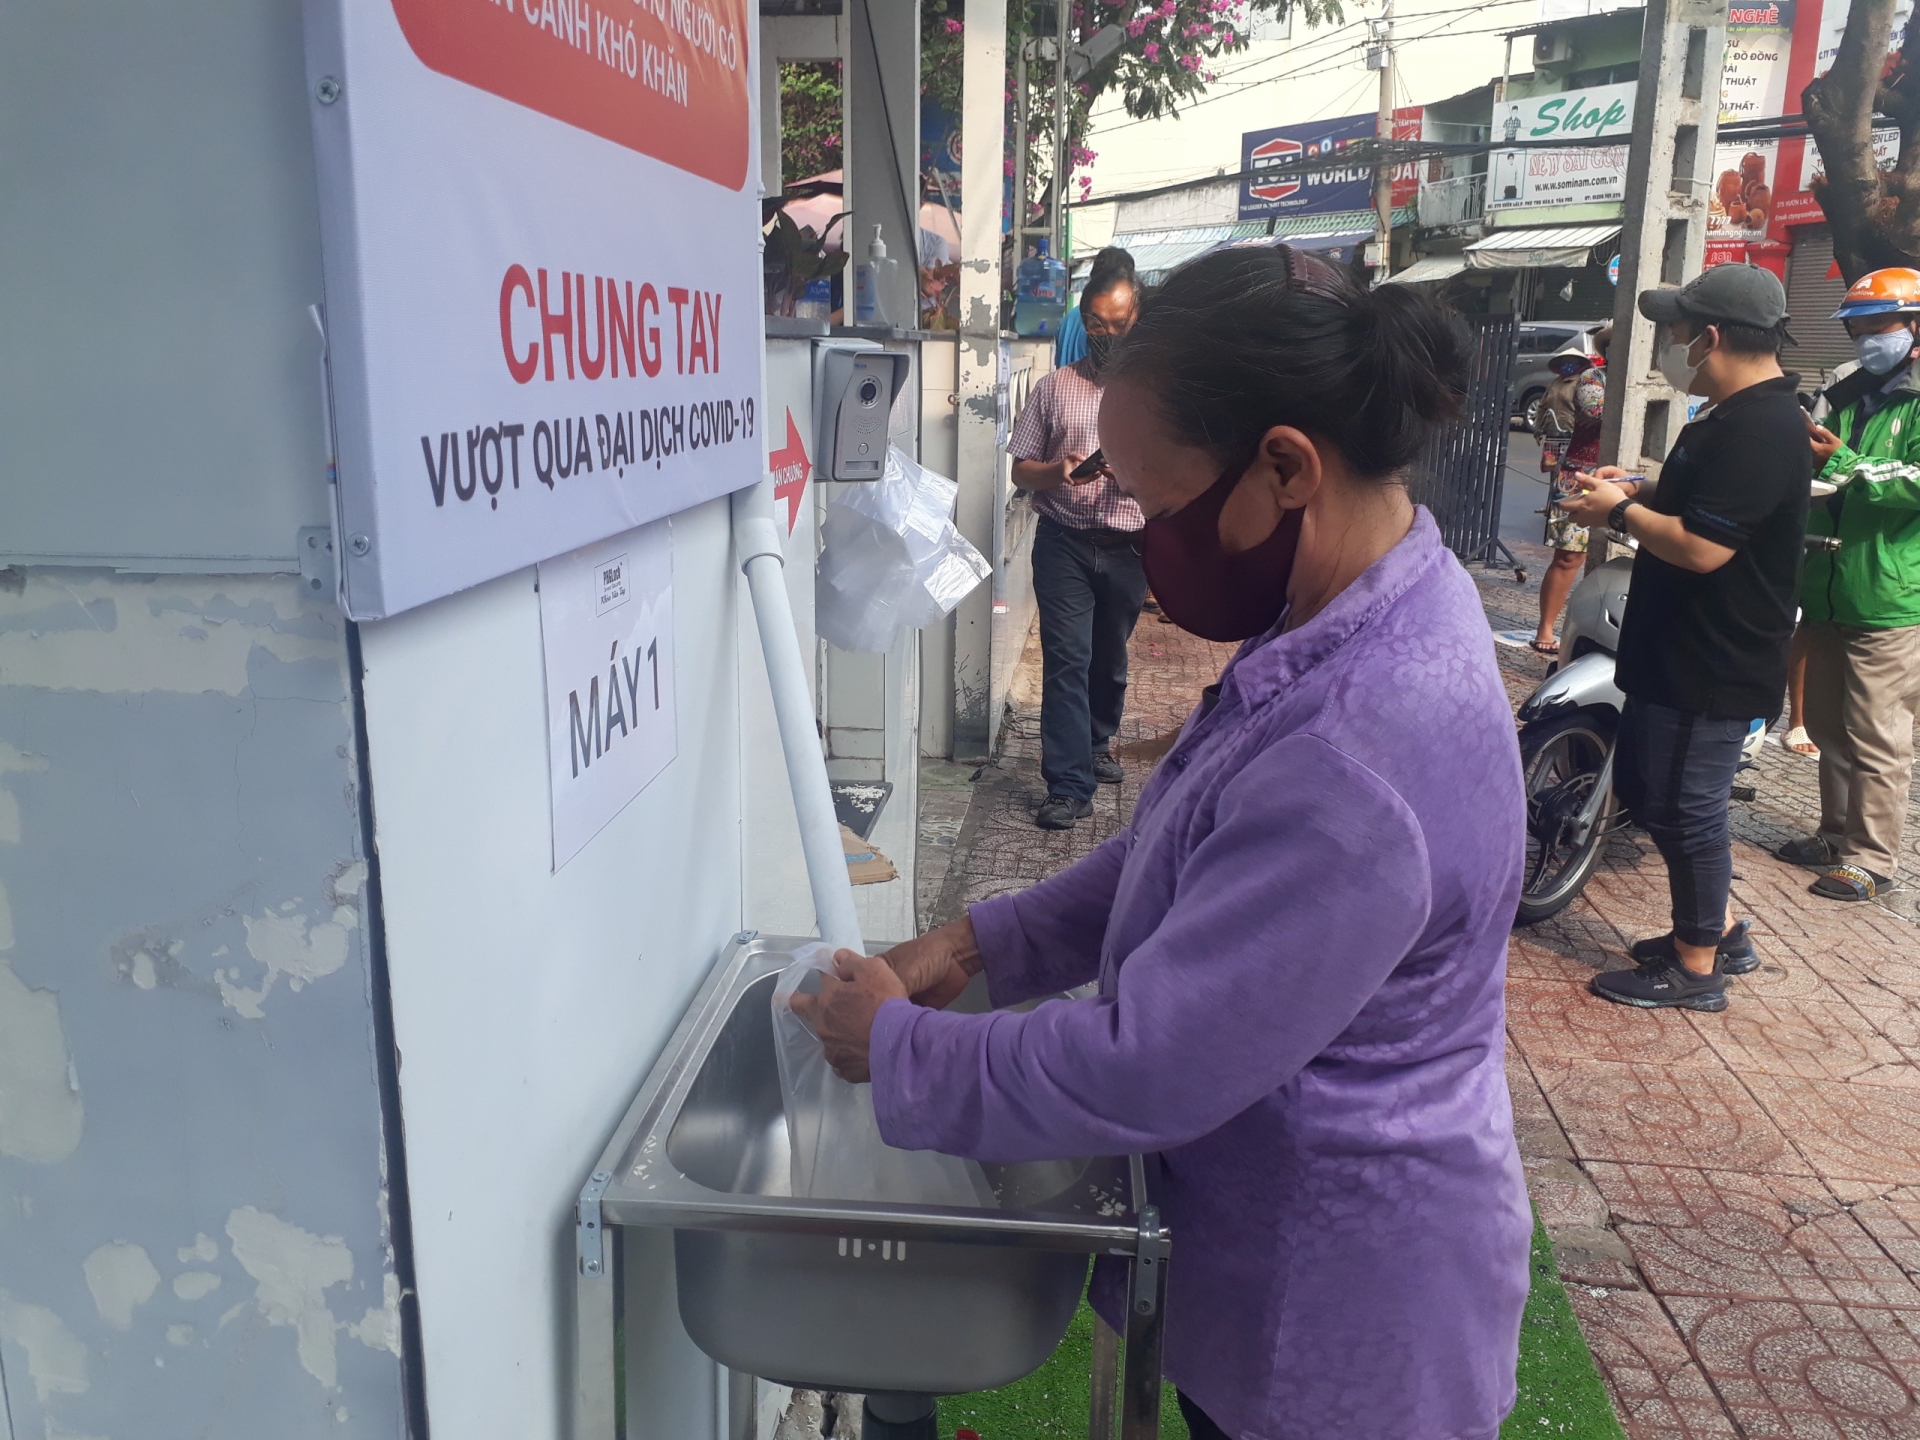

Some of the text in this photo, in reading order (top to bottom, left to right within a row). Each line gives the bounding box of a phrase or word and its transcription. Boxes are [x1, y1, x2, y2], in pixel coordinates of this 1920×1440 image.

[1729, 2, 1780, 25] NGHỀ
[596, 10, 637, 79] KHÓ
[642, 39, 688, 107] KHĂN
[718, 23, 736, 72] CÓ
[1750, 50, 1779, 62] ĐỒNG
[1725, 75, 1758, 88] THUẬT
[1529, 96, 1627, 137] Shop
[1254, 155, 1297, 184] TOA
[1306, 164, 1371, 187] WORLD
[500, 263, 722, 385] CHUNG TAY
[420, 396, 755, 512] VƯỢT QUA ĐẠI DỊCH COVID-19
[568, 635, 660, 780] MÁY 1
